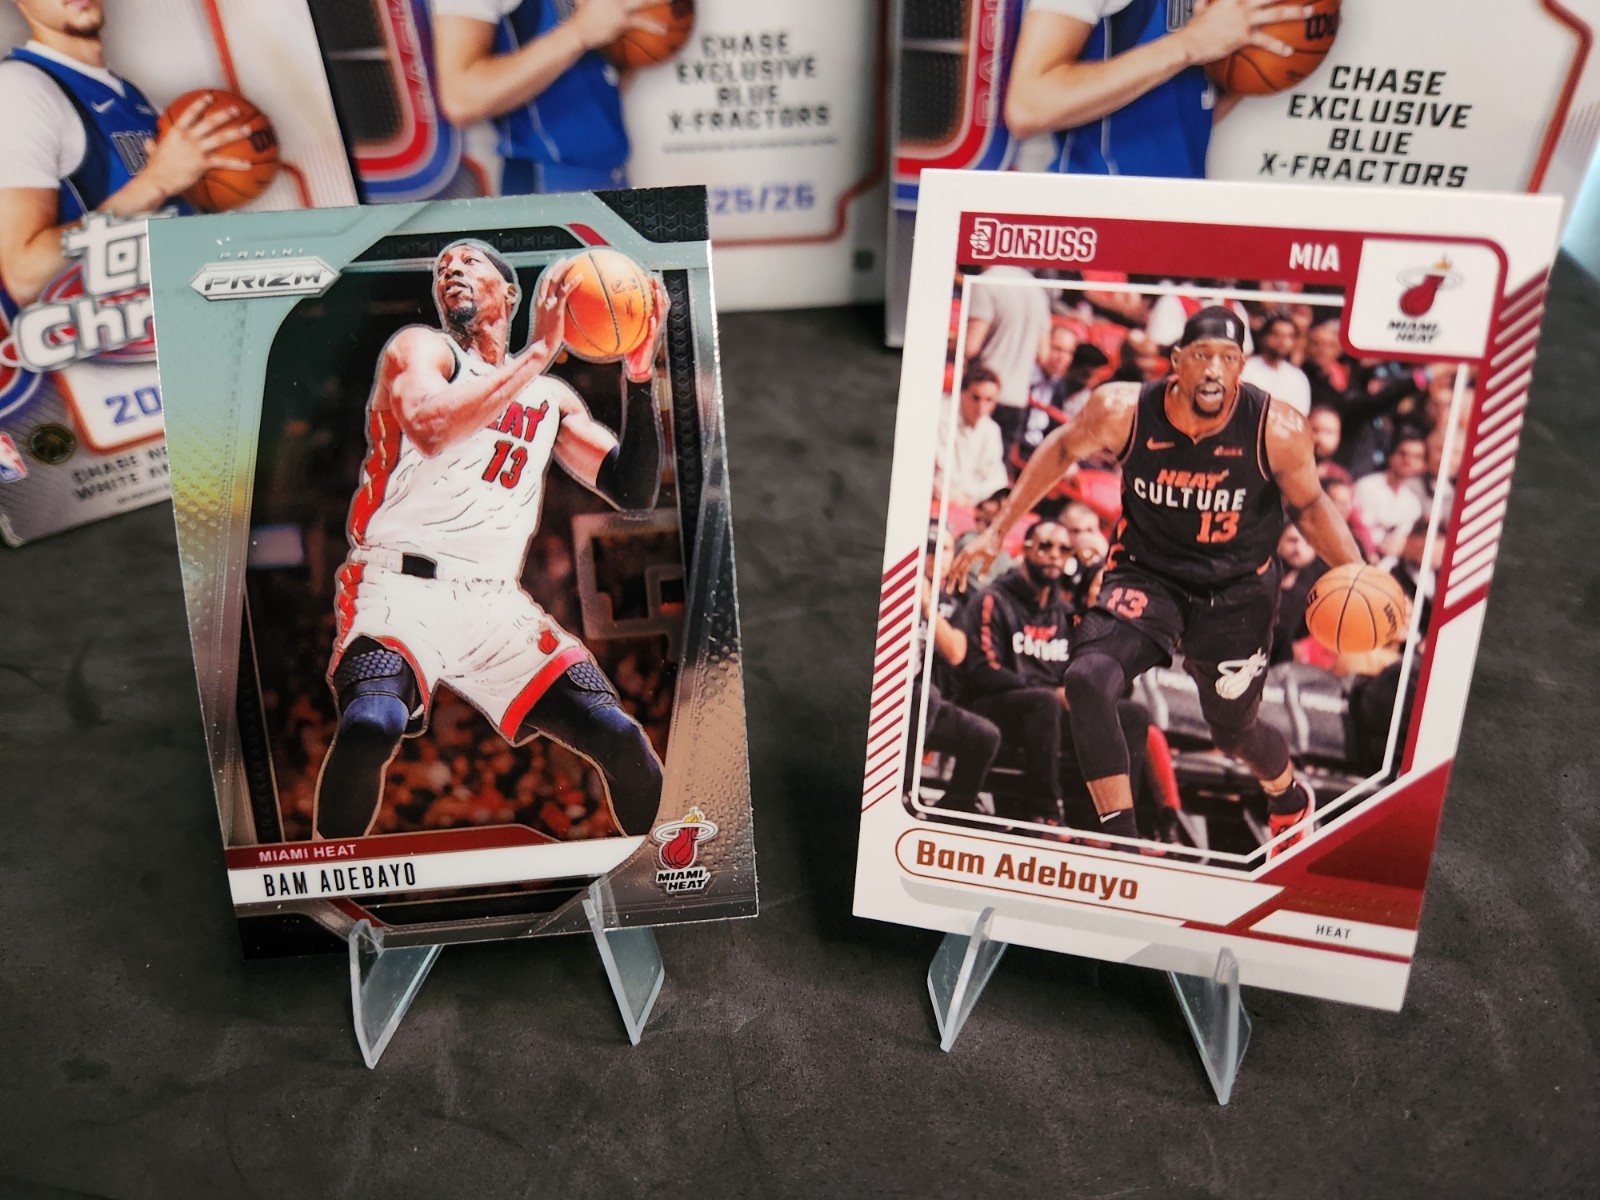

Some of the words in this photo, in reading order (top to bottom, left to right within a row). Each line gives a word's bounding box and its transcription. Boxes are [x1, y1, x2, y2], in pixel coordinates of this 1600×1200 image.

[702, 33, 788, 57] CHASE
[676, 56, 817, 84] EXCLUSIVE
[1329, 66, 1446, 96] CHASE
[718, 85, 778, 106] BLUE
[669, 105, 830, 132] X-FRACTORS
[1288, 95, 1472, 129] EXCLUSIVE
[1329, 128, 1413, 155] BLUE
[1259, 153, 1468, 188] X-FRACTORS
[970, 217, 1097, 262] DONRUSS
[219, 248, 303, 260] PANINI
[1289, 242, 1340, 271] MIA
[204, 270, 323, 291] PRIZM
[17, 297, 154, 369] Chr
[1387, 320, 1439, 331] MIAMI
[105, 387, 161, 425] 20
[482, 440, 528, 489] 13
[1157, 469, 1229, 490] HEAT
[1134, 477, 1247, 512] CULTURE
[1196, 511, 1241, 543] 13
[1106, 587, 1149, 618] 13
[259, 846, 308, 862] MIAMI
[314, 844, 356, 858] HEAT
[263, 871, 308, 897] BAM
[321, 862, 416, 893] ADEBAYO
[658, 870, 703, 881] MIAMI
[916, 839, 985, 875] Bam
[994, 853, 1139, 901] Adebayo
[668, 878, 706, 891] HEAT
[1315, 923, 1352, 940] HEAT
